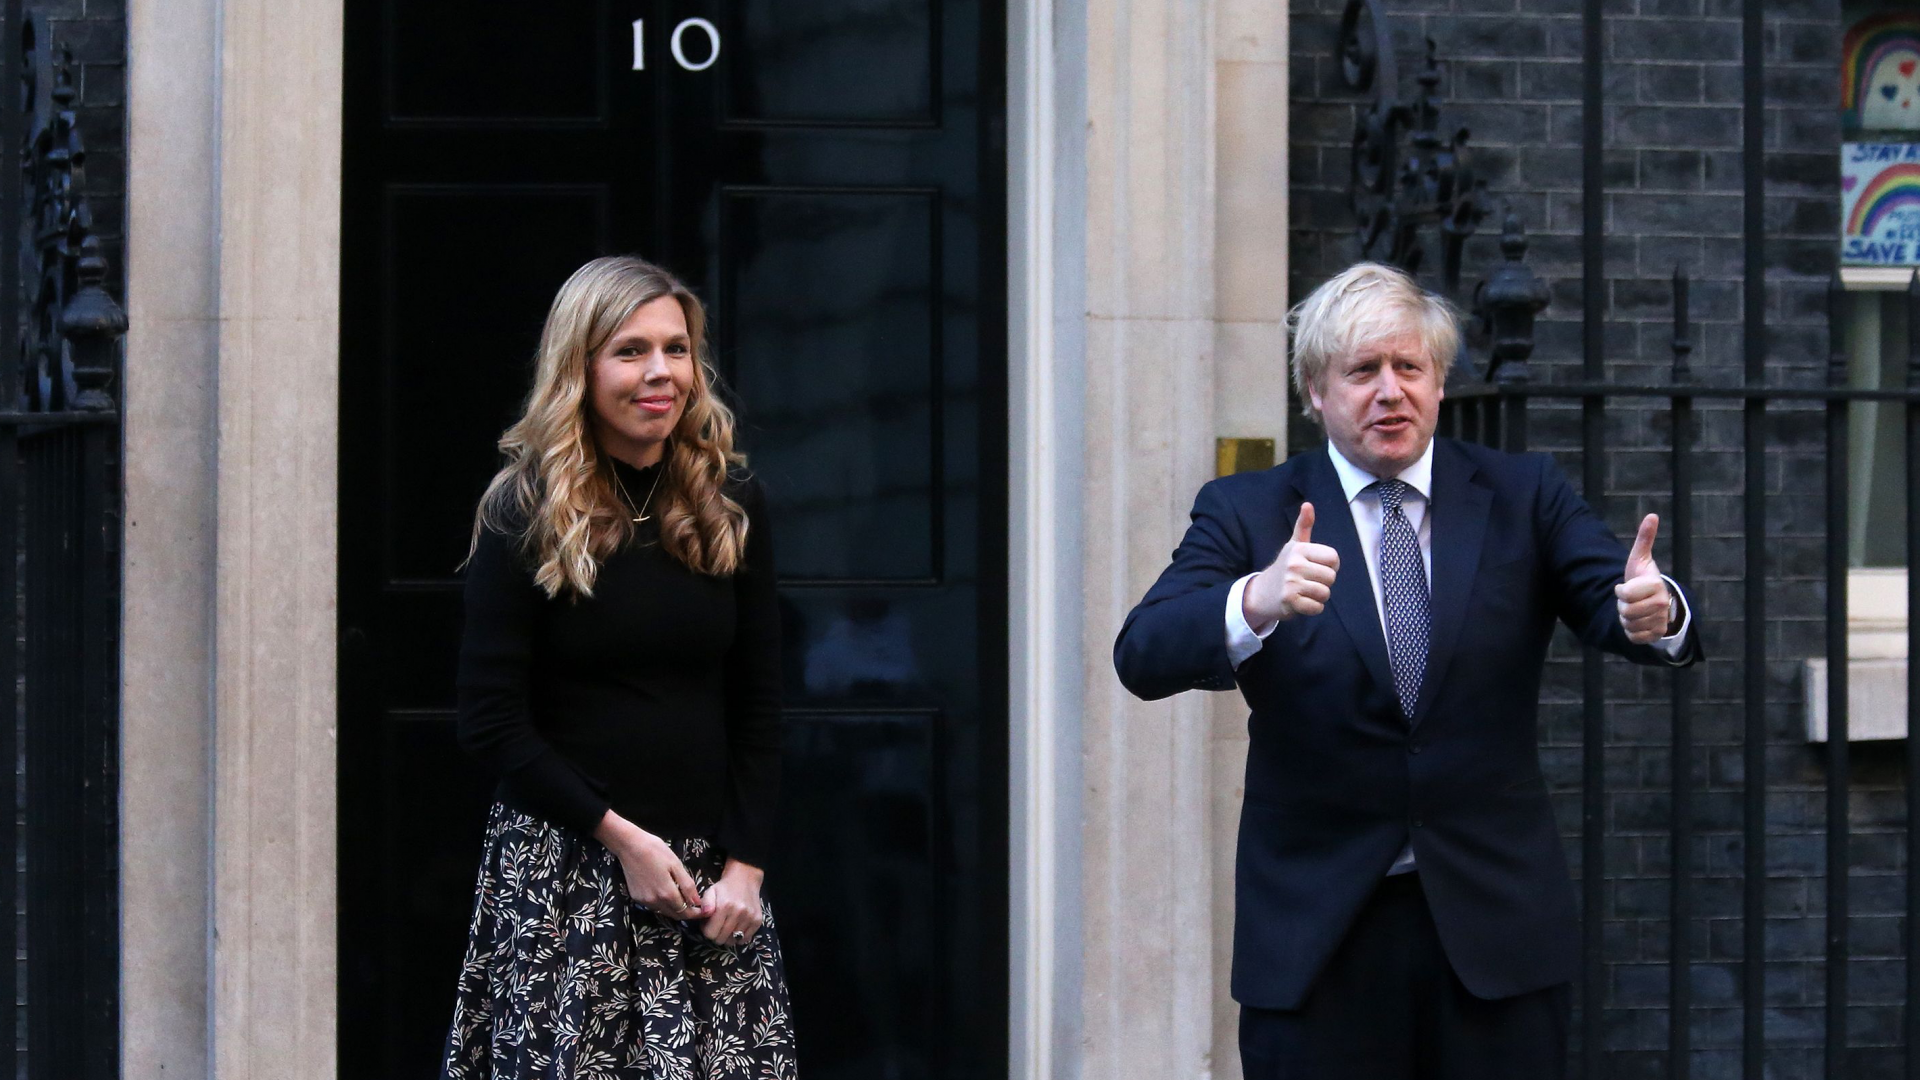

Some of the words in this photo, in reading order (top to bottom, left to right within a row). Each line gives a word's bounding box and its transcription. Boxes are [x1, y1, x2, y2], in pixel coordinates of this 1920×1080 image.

[632, 17, 720, 71] 10
[1851, 143, 1904, 162] STAY
[1843, 239, 1905, 262] SAVE
